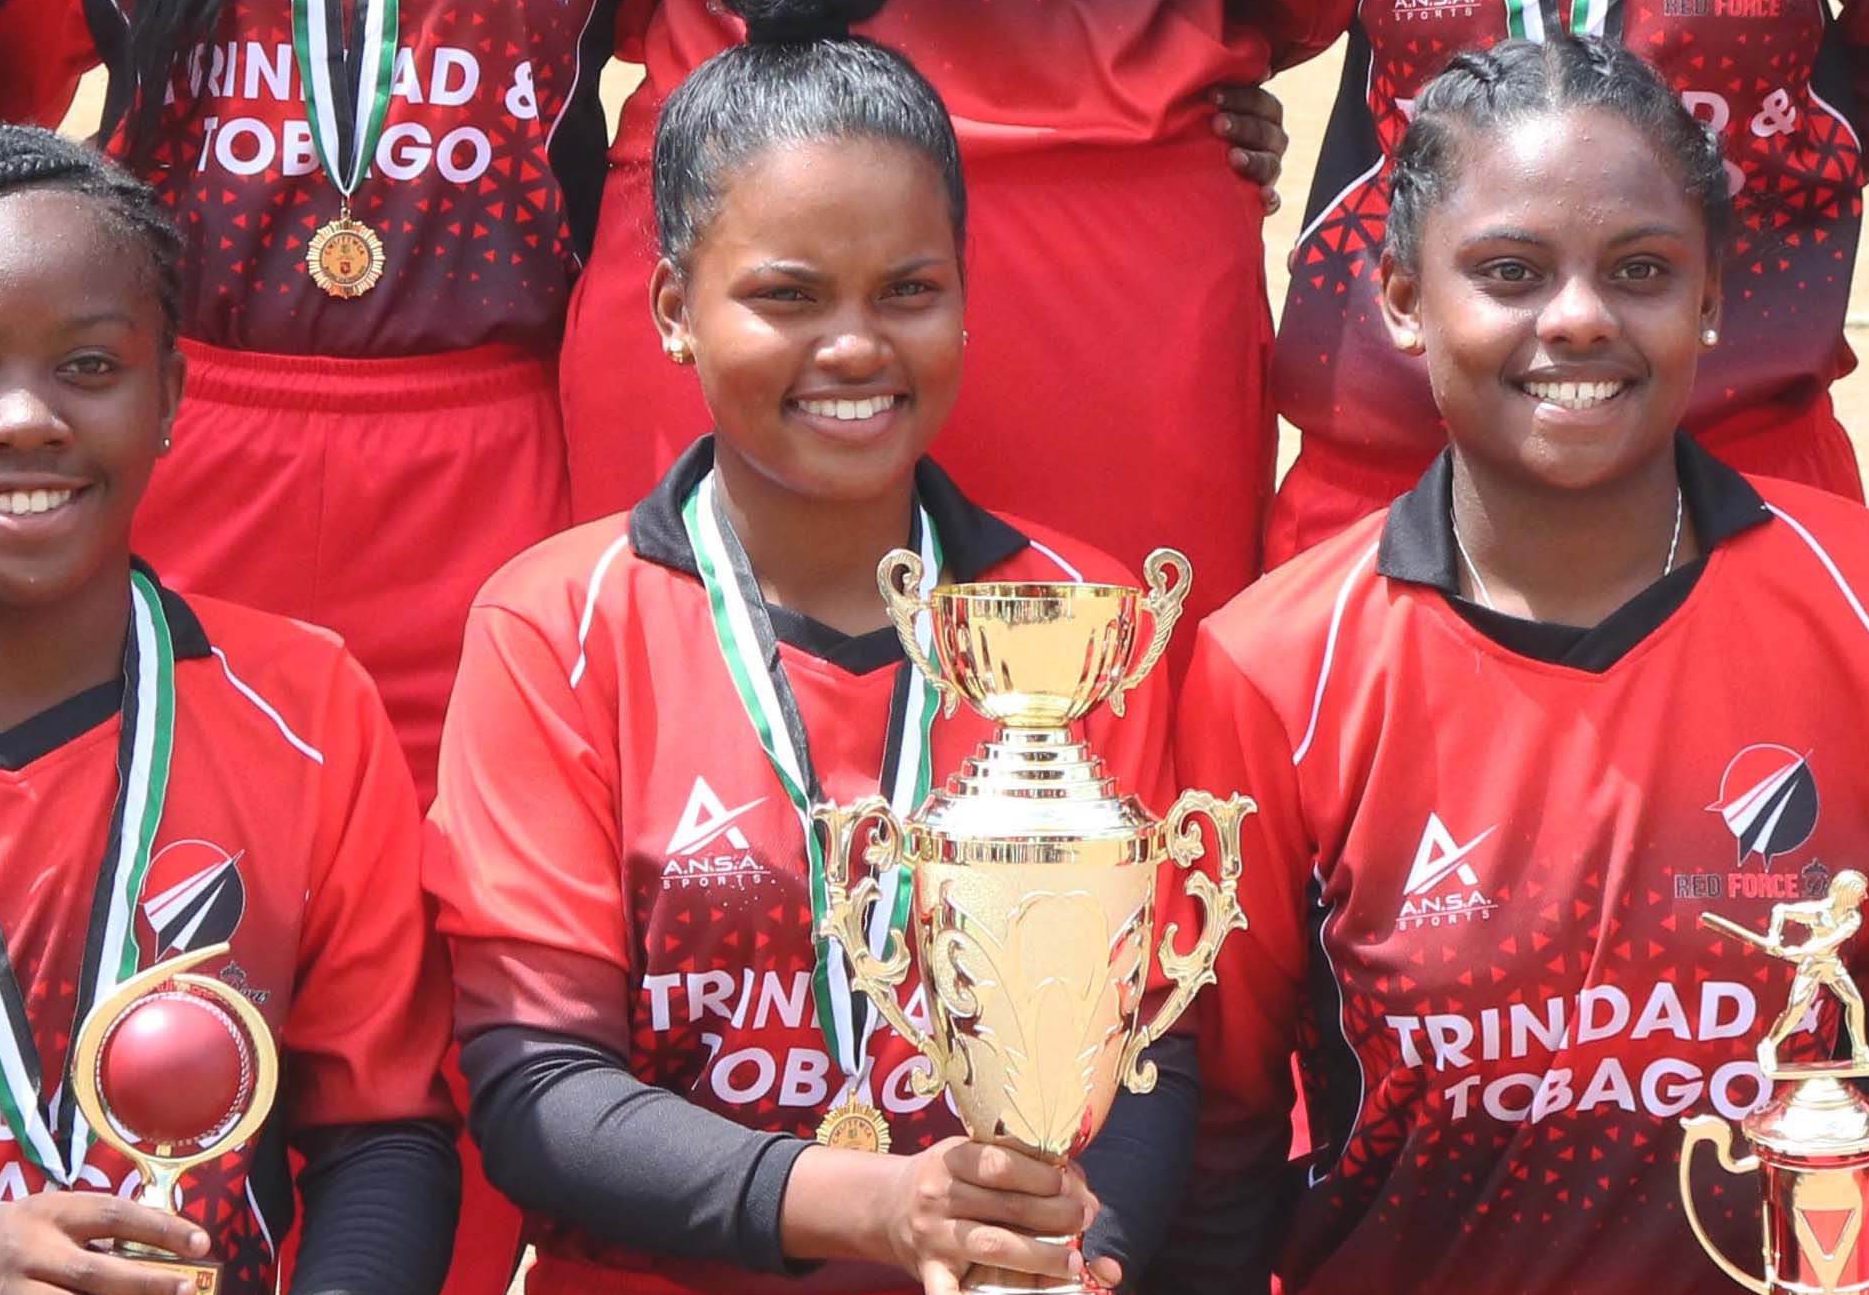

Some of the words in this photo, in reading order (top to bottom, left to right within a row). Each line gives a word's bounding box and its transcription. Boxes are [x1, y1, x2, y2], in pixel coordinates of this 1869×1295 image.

[1751, 89, 1797, 137] &
[663, 854, 765, 876] A.N.S.A.
[663, 873, 761, 890] SPORTS
[1674, 874, 1721, 899] RED
[1727, 873, 1799, 898] FORCE
[1399, 890, 1492, 917] A.N.S.A.
[1399, 908, 1490, 931] SPORTS
[1444, 1057, 1773, 1123] TOBAGO
